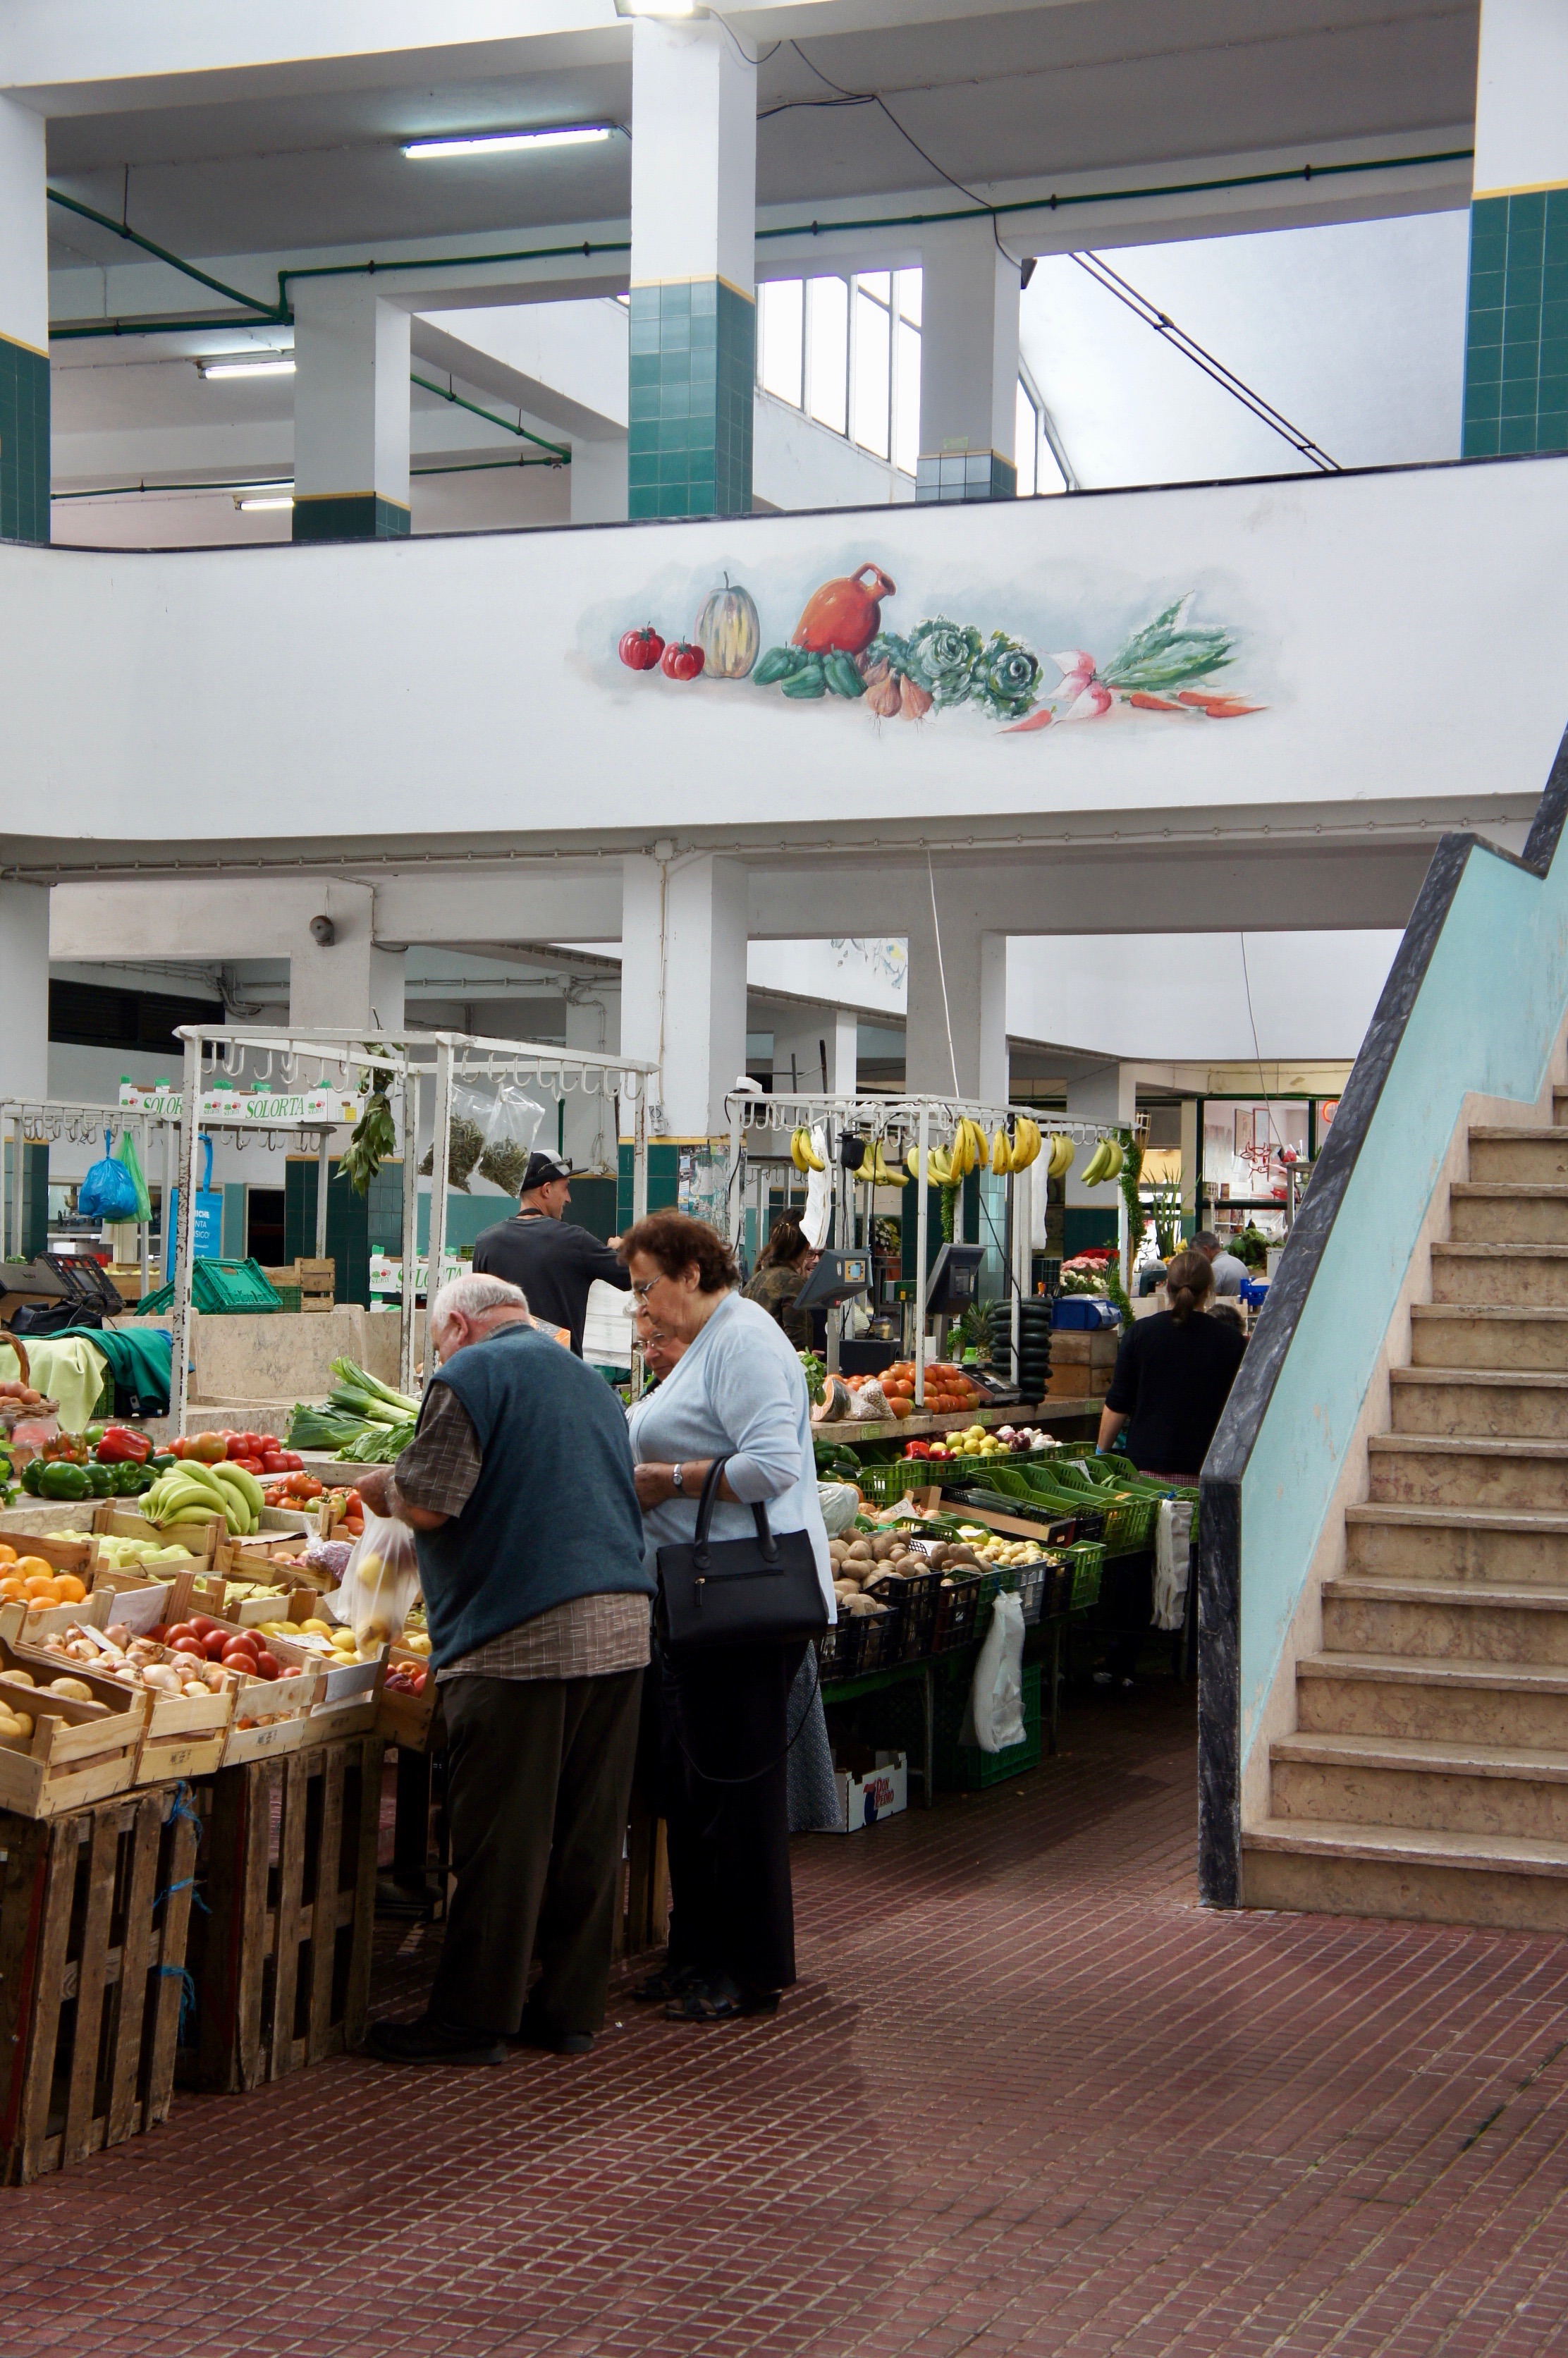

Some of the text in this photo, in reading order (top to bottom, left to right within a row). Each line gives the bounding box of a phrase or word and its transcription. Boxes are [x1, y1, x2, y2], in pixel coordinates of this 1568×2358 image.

[143, 1097, 183, 1114] SOLOR
[245, 1097, 304, 1118] SOLORTA
[876, 1777, 890, 1793] DON
[874, 1789, 894, 1809] PEDRO
